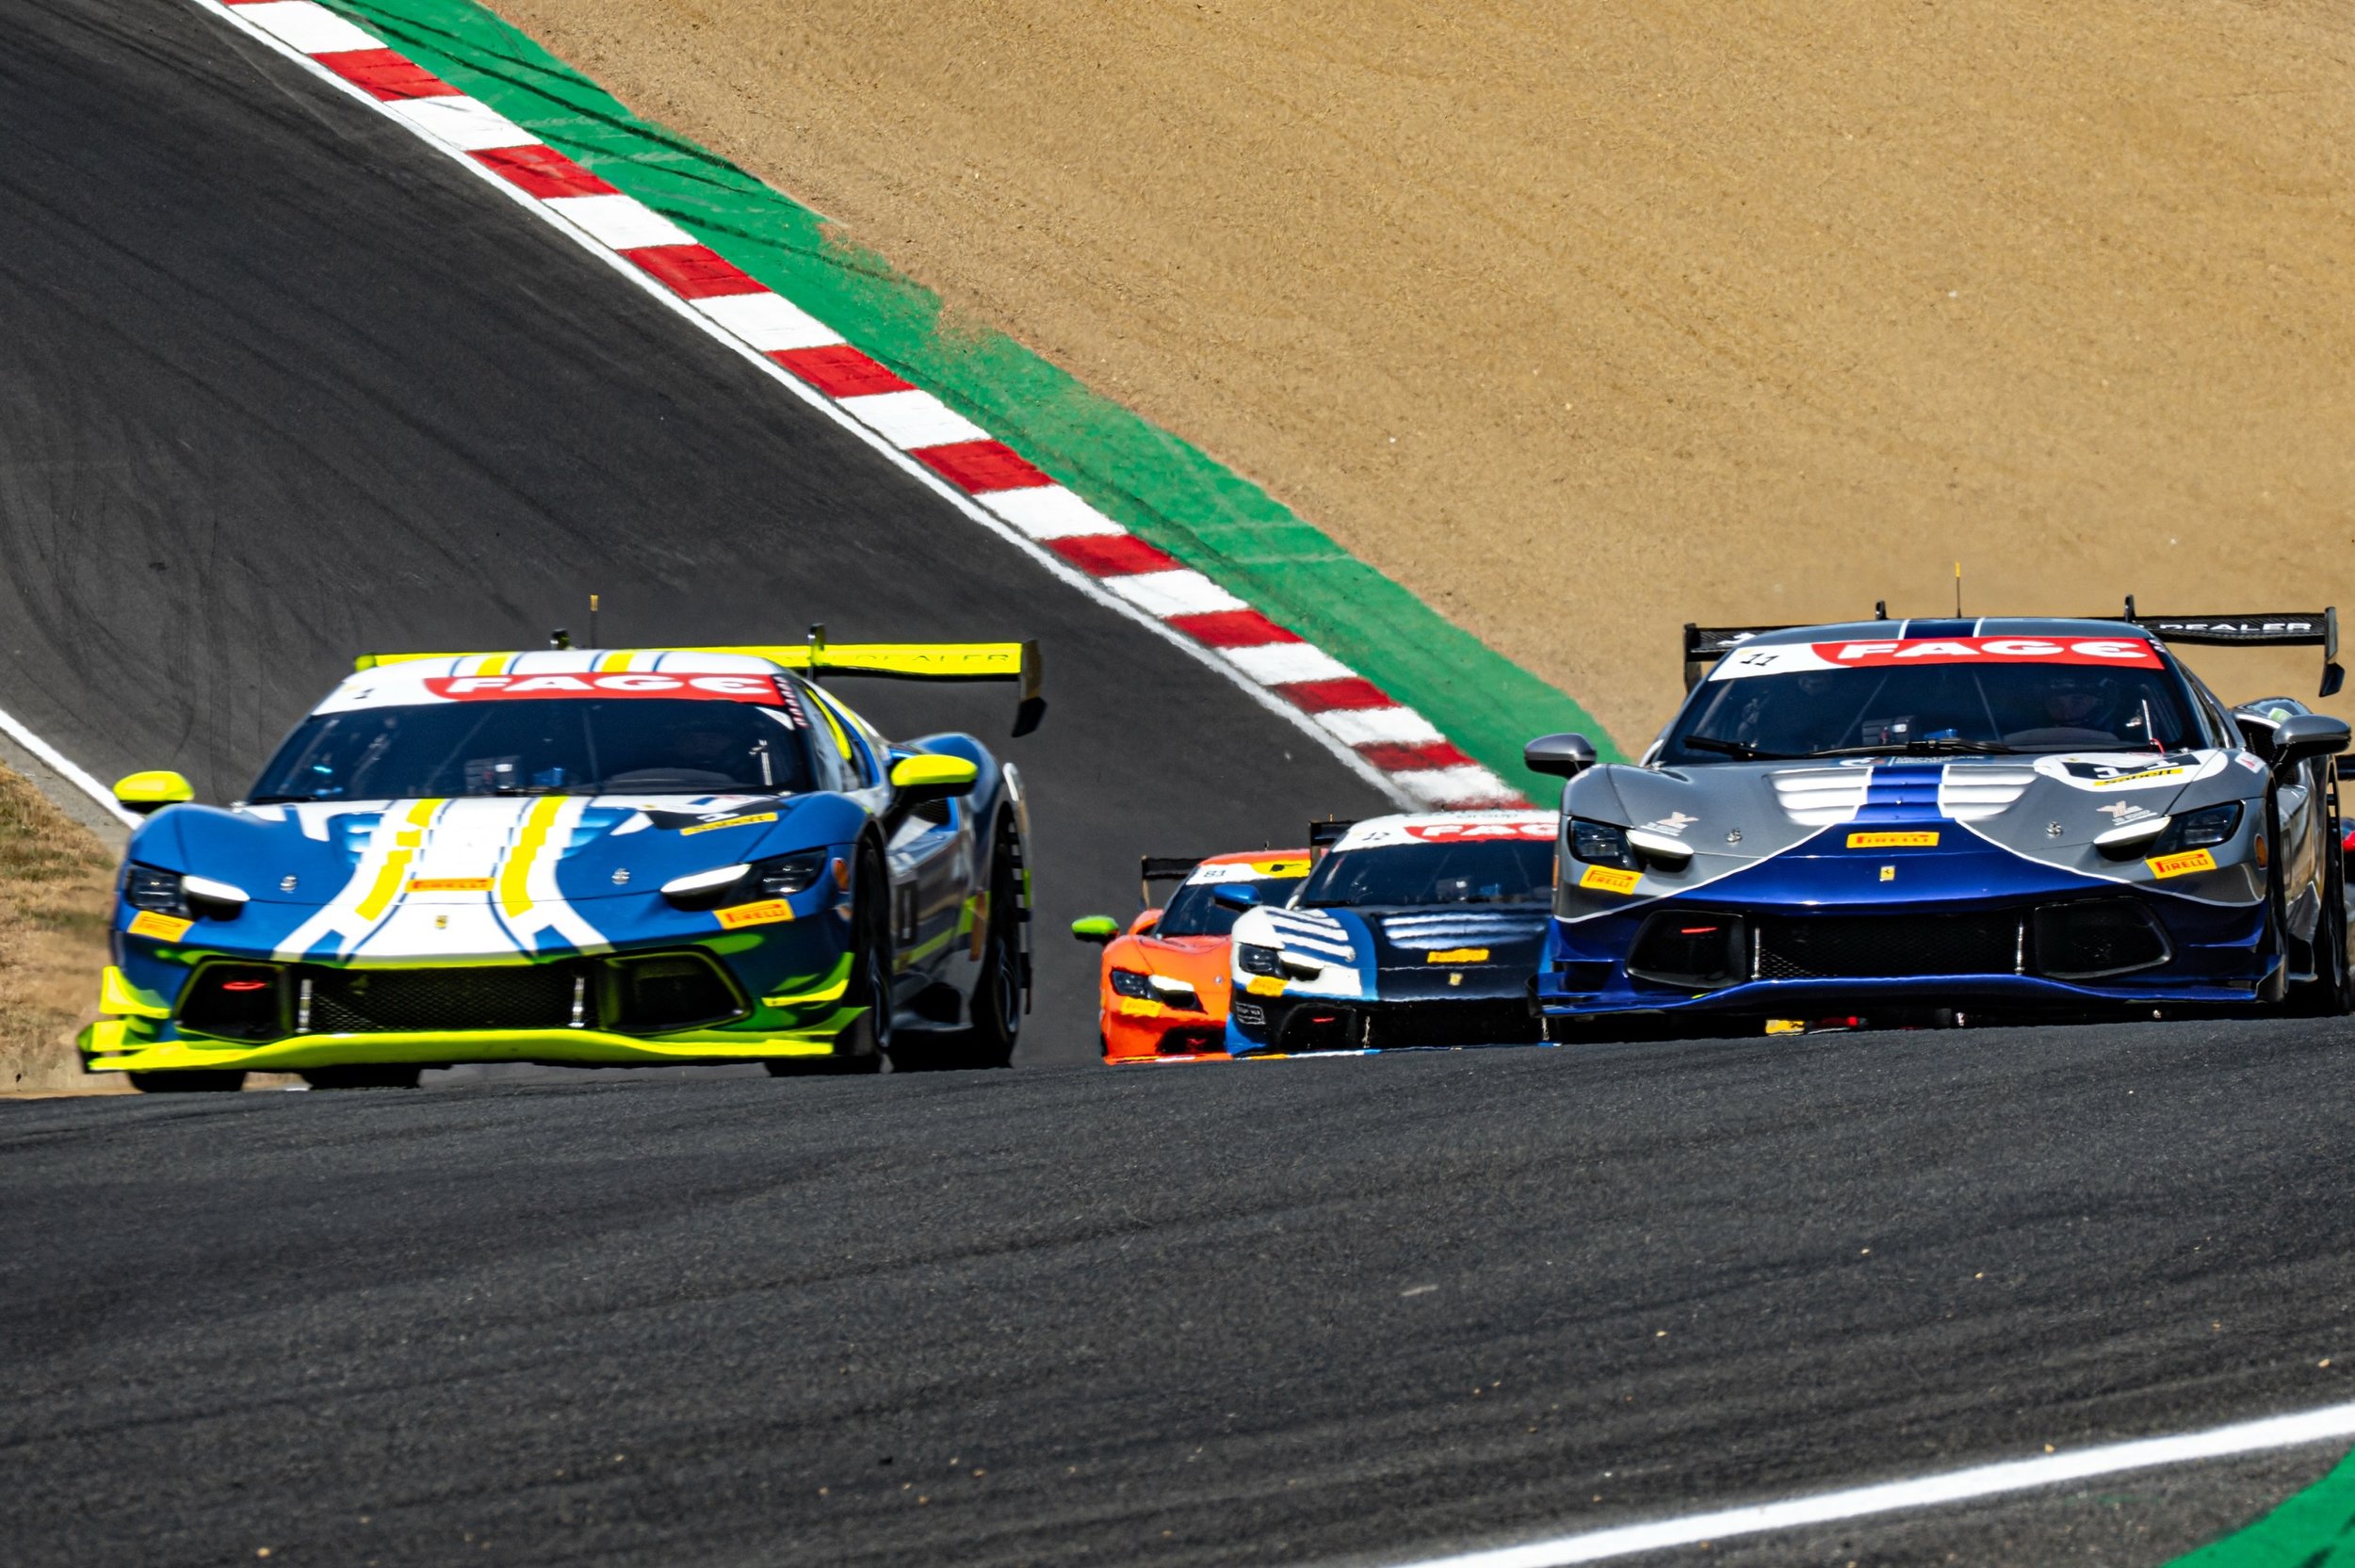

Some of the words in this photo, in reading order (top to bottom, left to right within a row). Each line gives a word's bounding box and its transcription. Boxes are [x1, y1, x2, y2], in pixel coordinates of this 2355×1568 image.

[1837, 639, 2149, 659] FAGE
[1739, 652, 1780, 667] 11
[444, 673, 774, 695] FAGE
[1421, 823, 1560, 836] FAG
[2153, 853, 2209, 874] PIRELLI
[1587, 869, 1634, 888] PIRELLI
